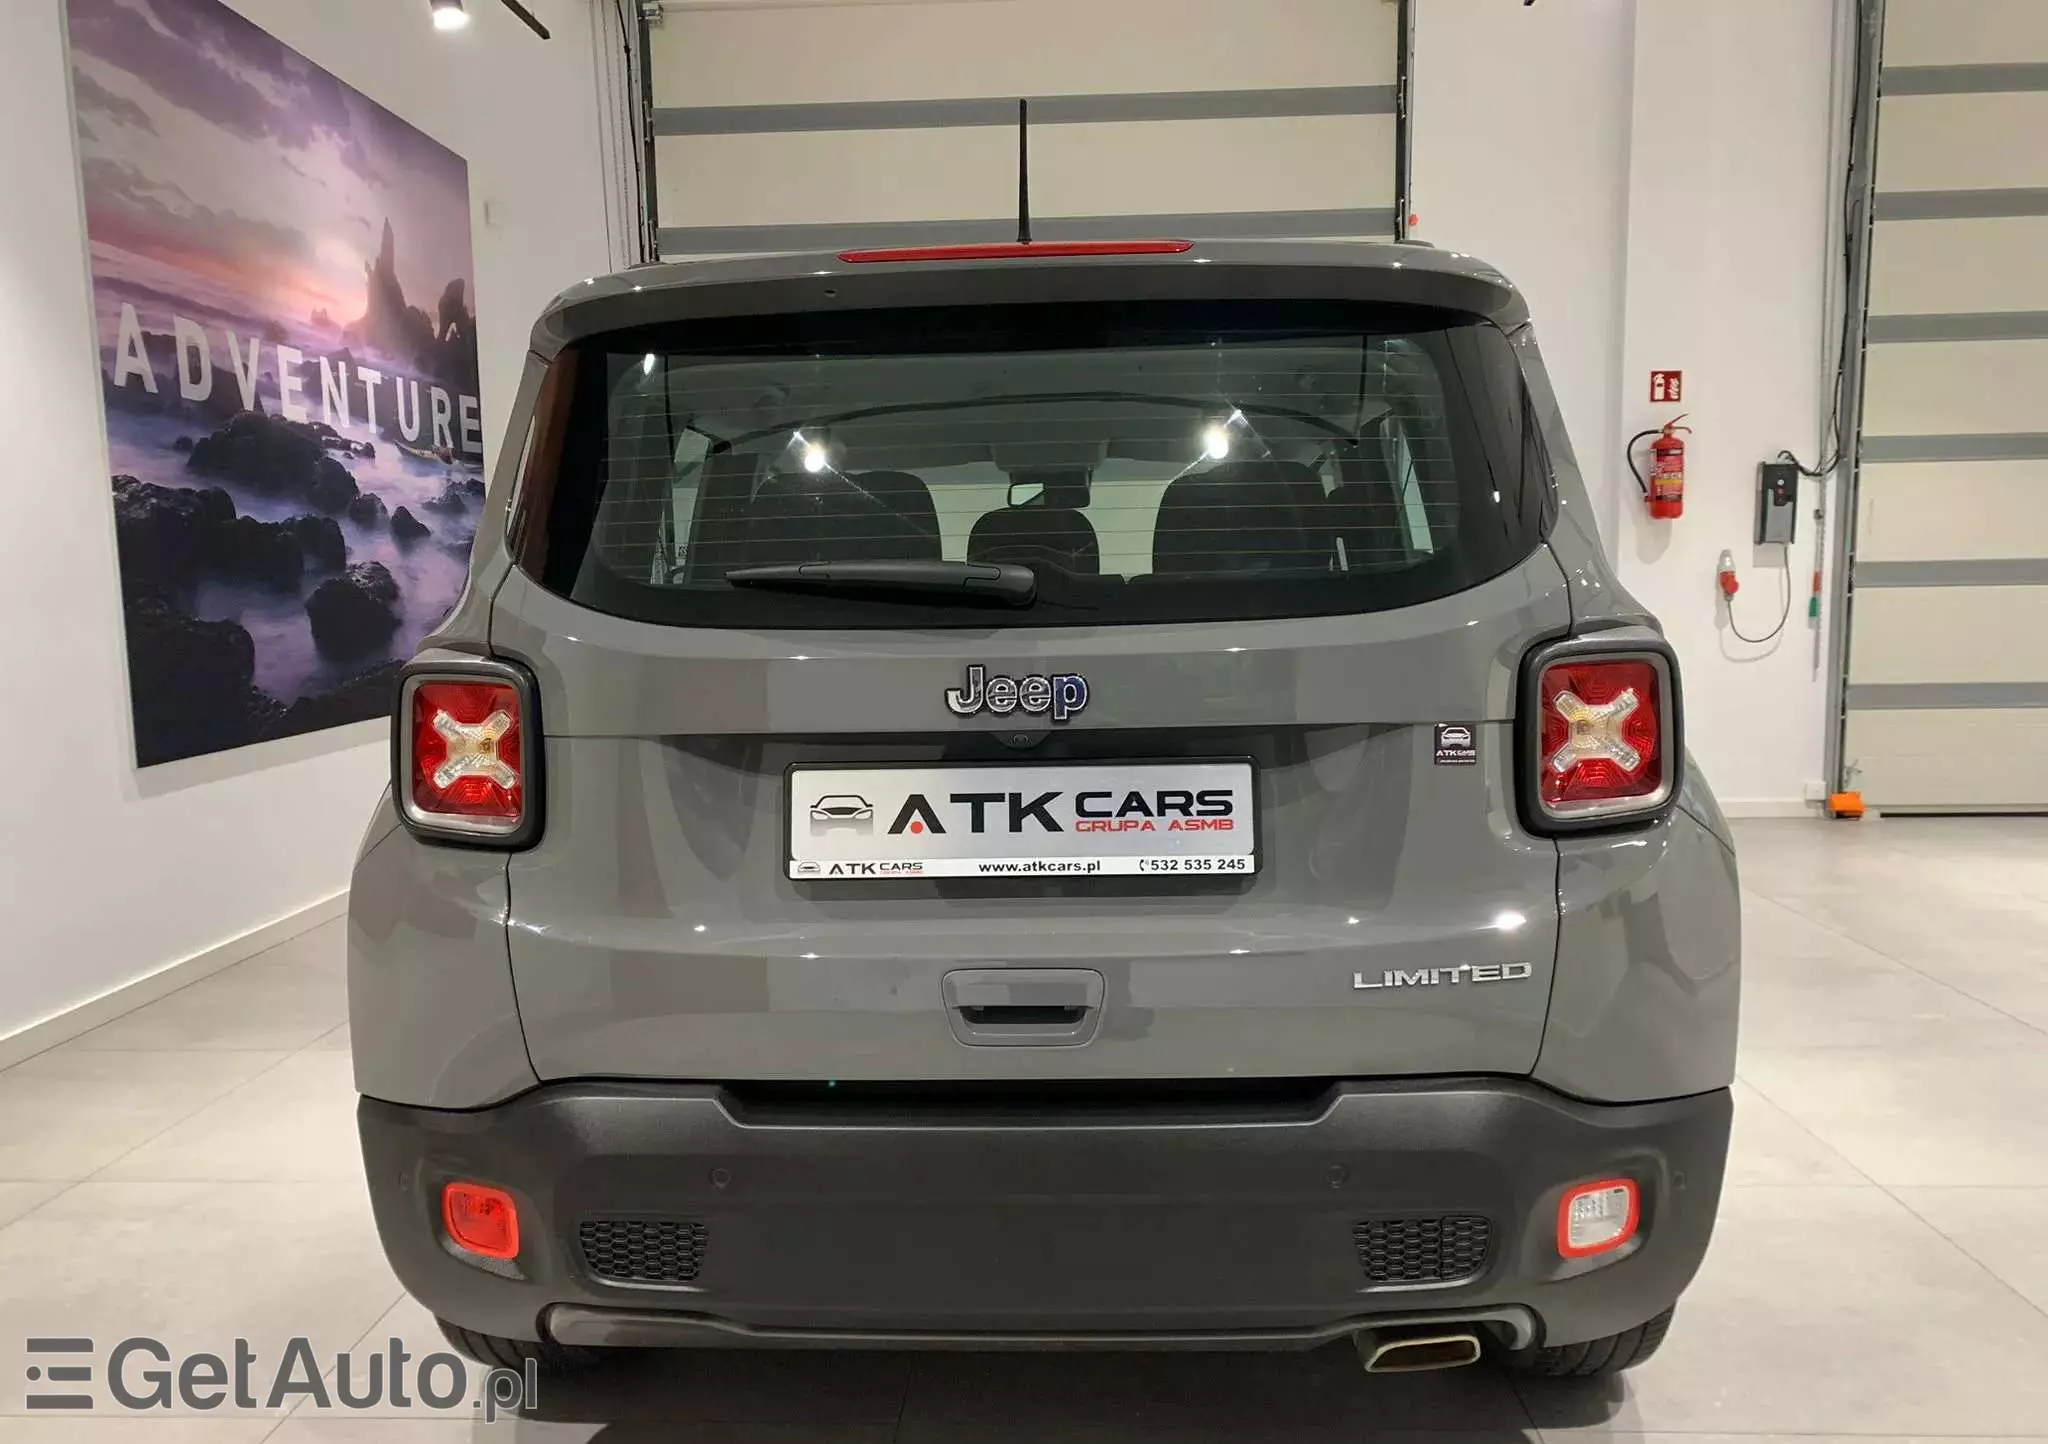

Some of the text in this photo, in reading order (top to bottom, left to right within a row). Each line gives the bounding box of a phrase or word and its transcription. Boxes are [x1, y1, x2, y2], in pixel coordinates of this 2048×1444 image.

[113, 303, 483, 455] ADVENTURE
[944, 664, 1089, 721] Jeep
[887, 789, 1234, 834] ATK CARS
[1074, 818, 1235, 833] GRUPA ASMB
[829, 863, 876, 875] ATK
[879, 862, 923, 871] CARS
[978, 860, 1101, 874] www.atkcars.pl
[1151, 858, 1246, 871] 532 535 245
[1353, 962, 1532, 989] LIMITED
